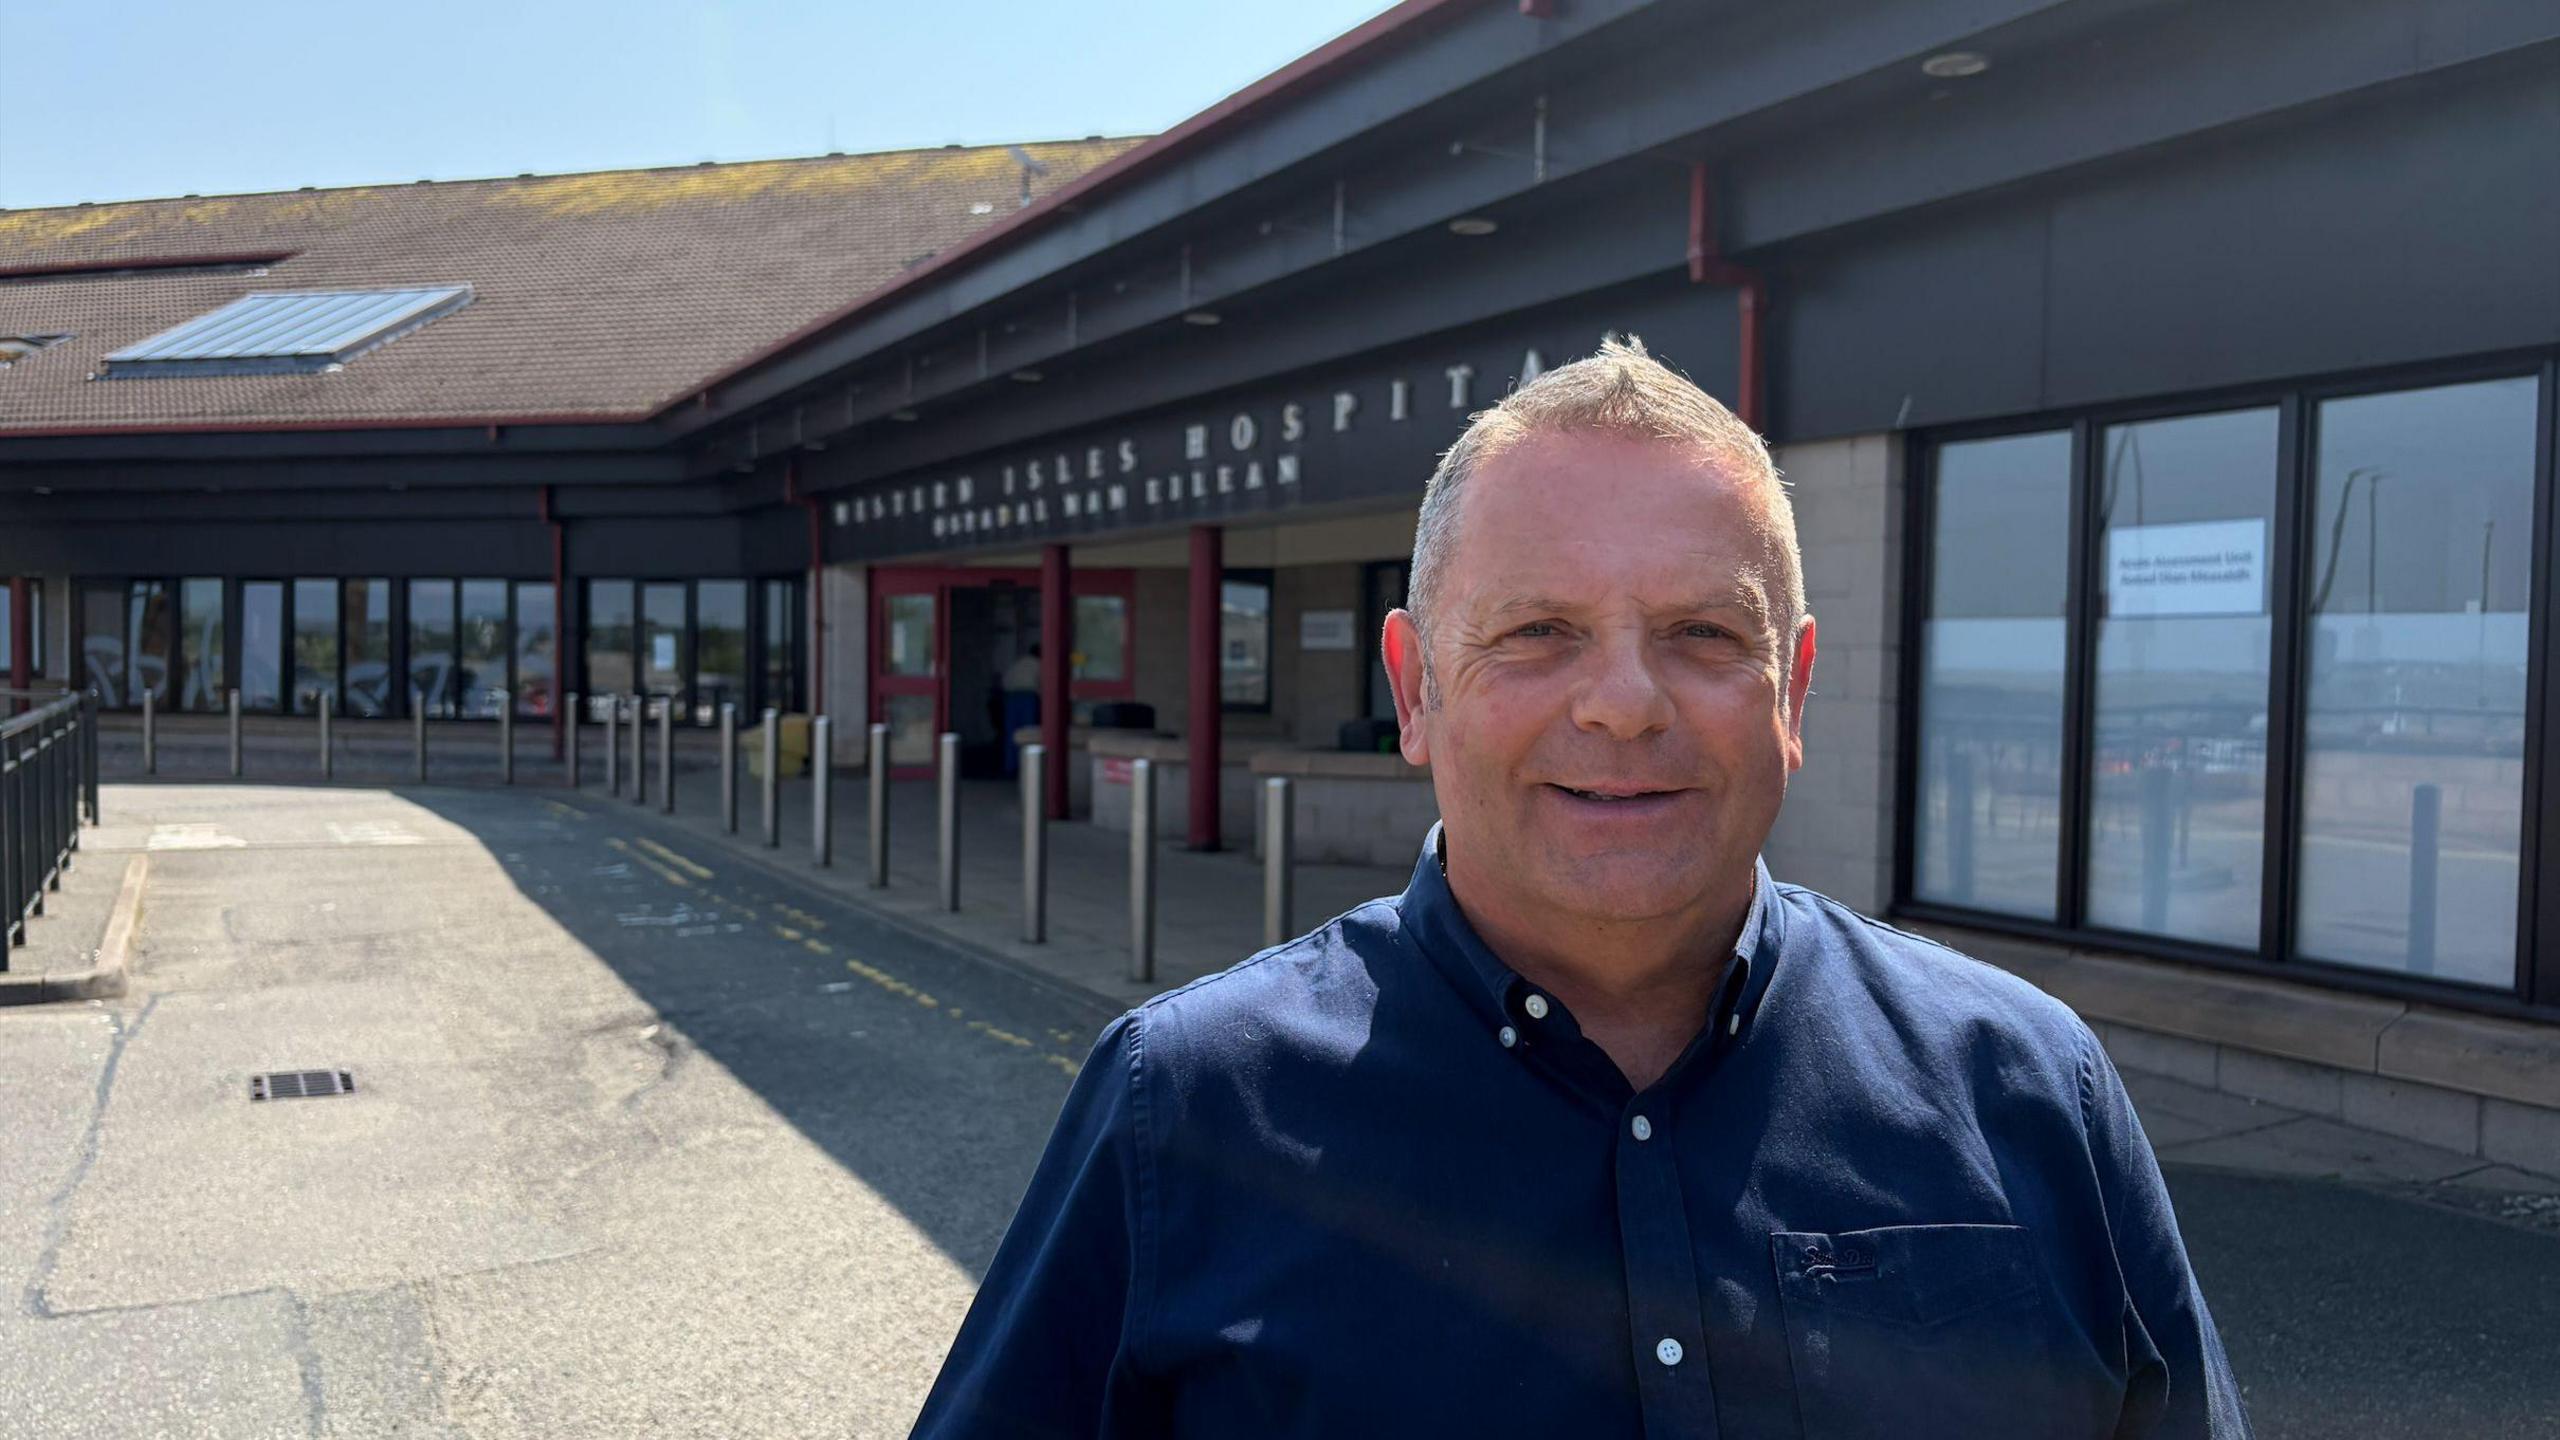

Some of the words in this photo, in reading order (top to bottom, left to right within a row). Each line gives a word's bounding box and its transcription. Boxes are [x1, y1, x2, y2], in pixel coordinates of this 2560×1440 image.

[1003, 440, 1135, 496] ISLES
[1186, 329, 1620, 461] HOSPITA
[1145, 455, 1299, 505] EILEAN
